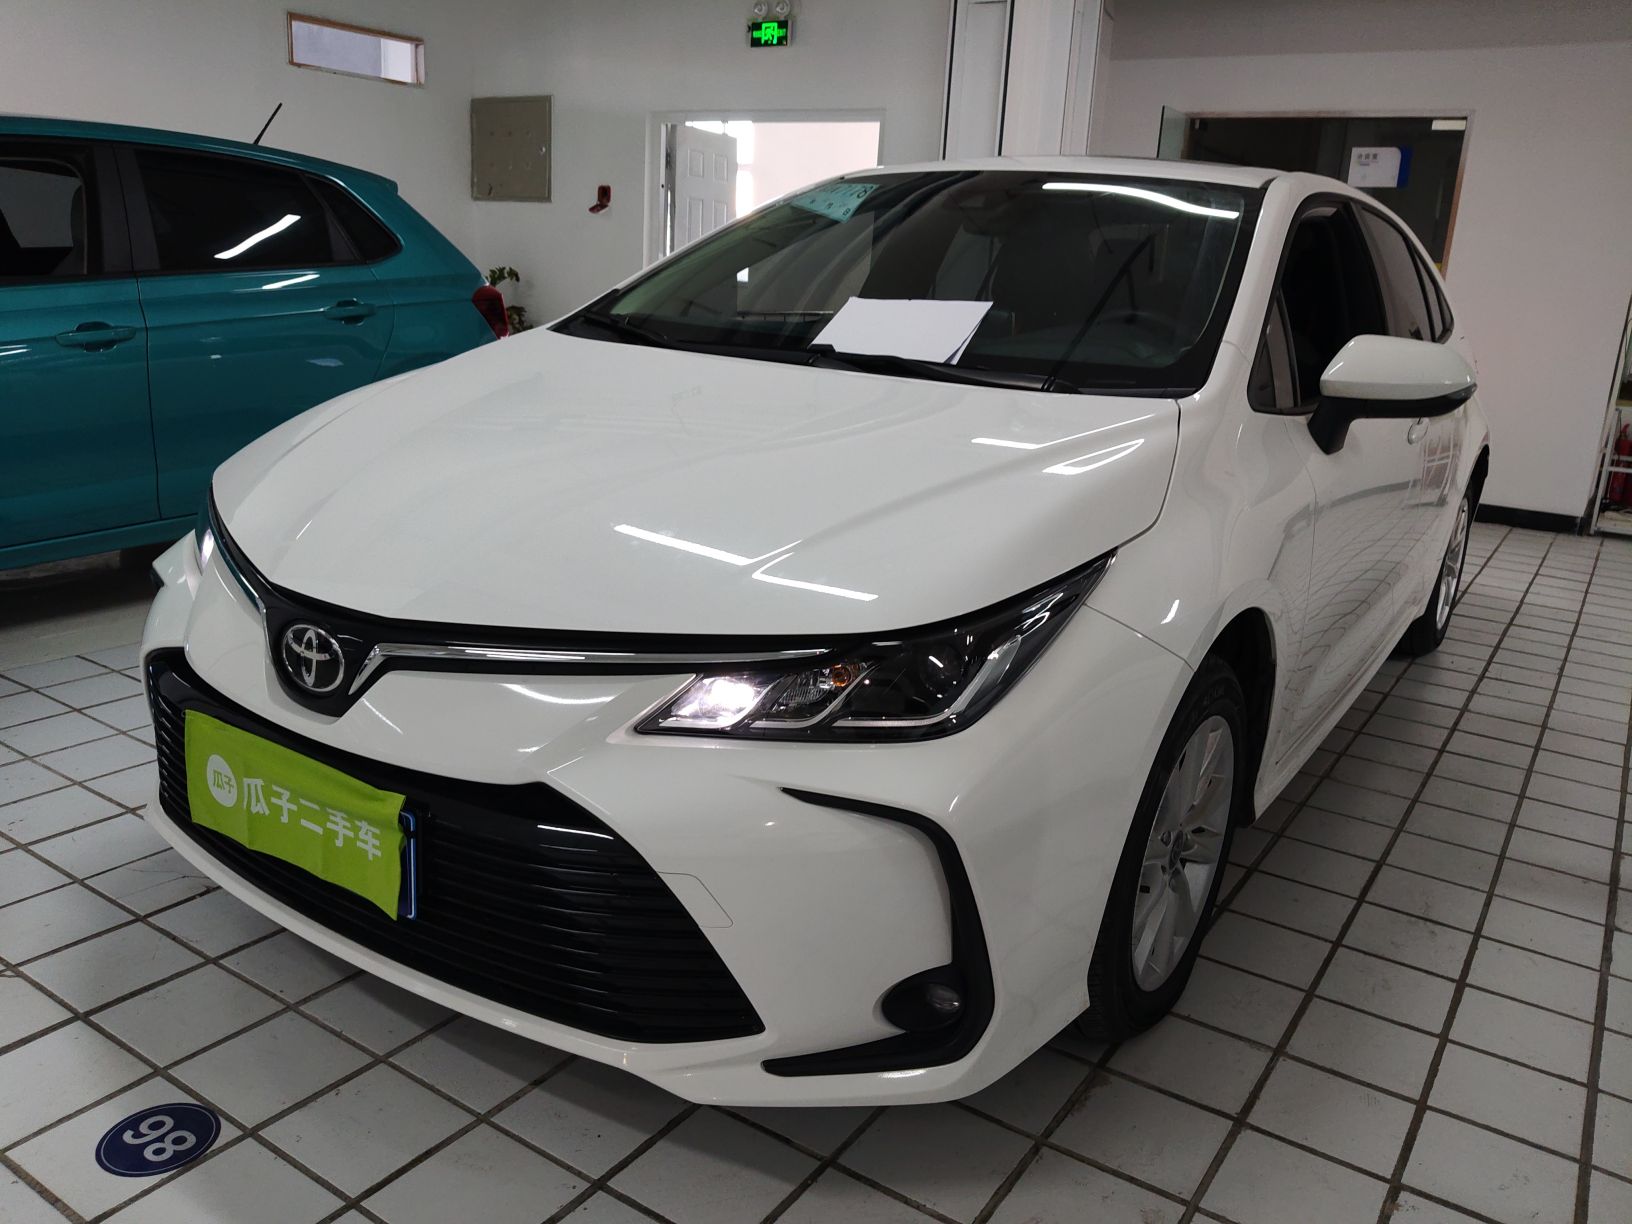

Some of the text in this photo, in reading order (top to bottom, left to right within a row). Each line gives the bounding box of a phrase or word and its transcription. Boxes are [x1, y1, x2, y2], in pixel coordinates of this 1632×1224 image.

[213, 769, 234, 794] 瓜子
[243, 778, 381, 861] 瓜子二手车
